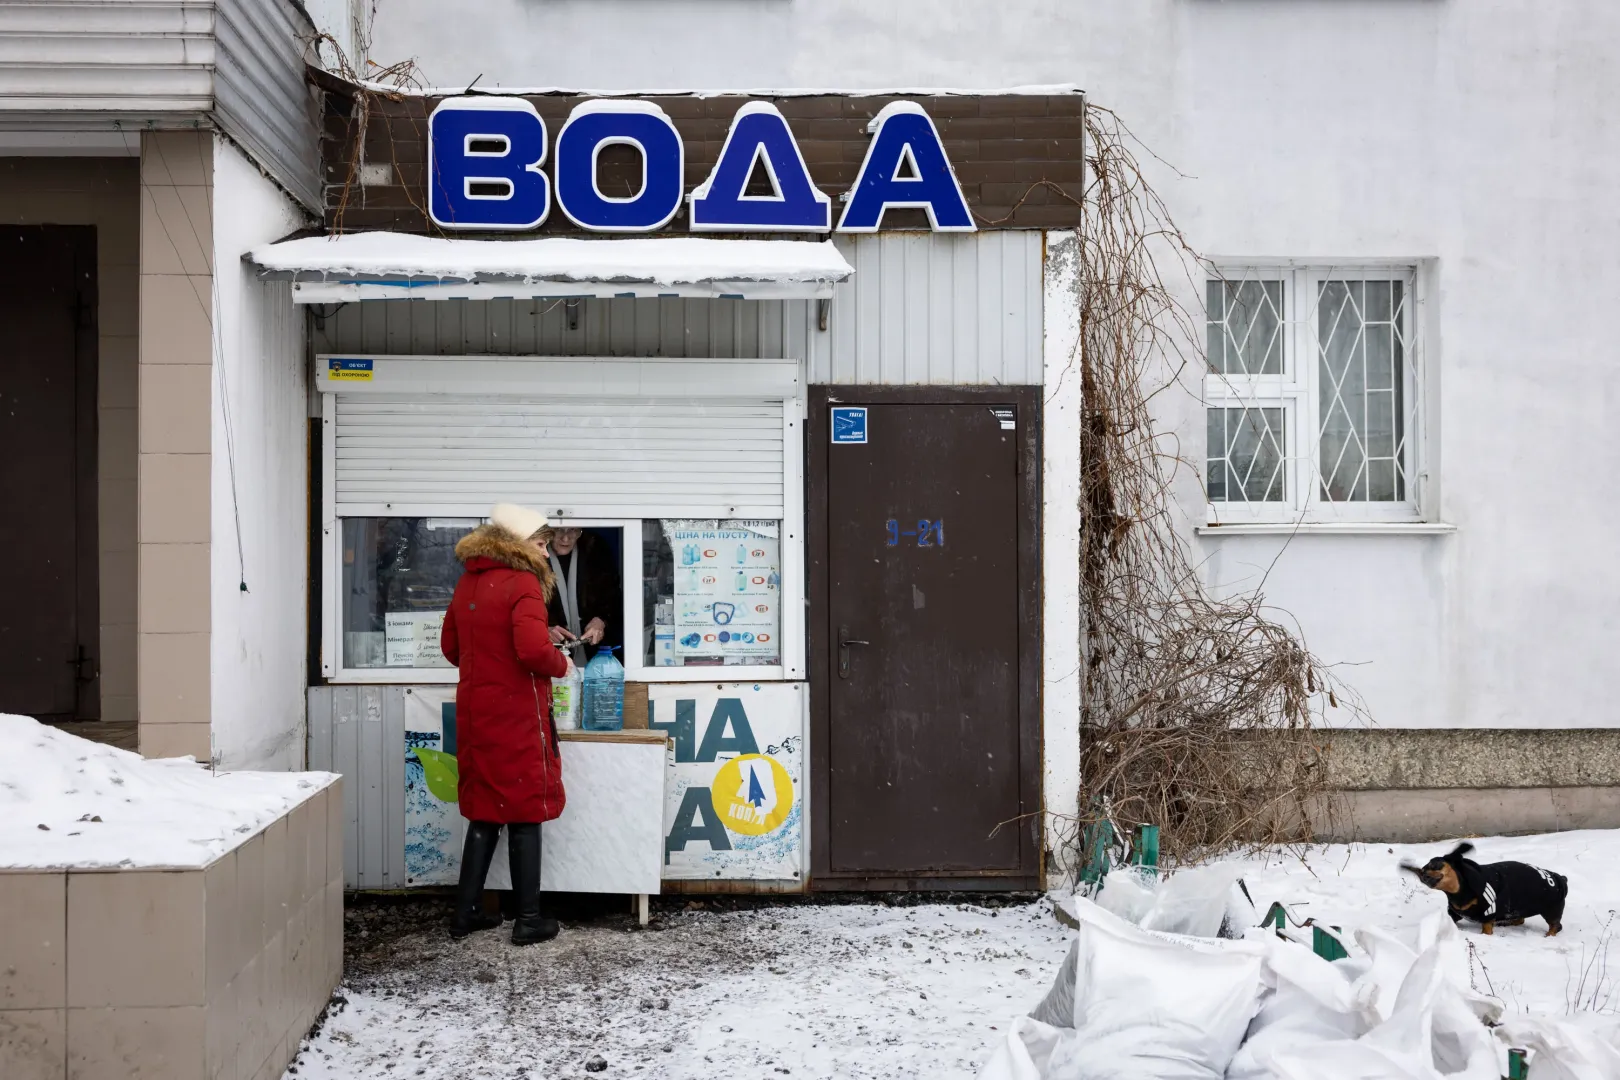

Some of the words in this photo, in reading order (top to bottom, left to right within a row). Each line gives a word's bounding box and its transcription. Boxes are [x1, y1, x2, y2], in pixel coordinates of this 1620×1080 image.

[428, 98, 977, 232] ВОДА
[675, 531, 699, 540] ЦІНА
[702, 531, 716, 539] НА
[719, 531, 748, 539] ПУСТУ
[886, 519, 944, 546] 9-21
